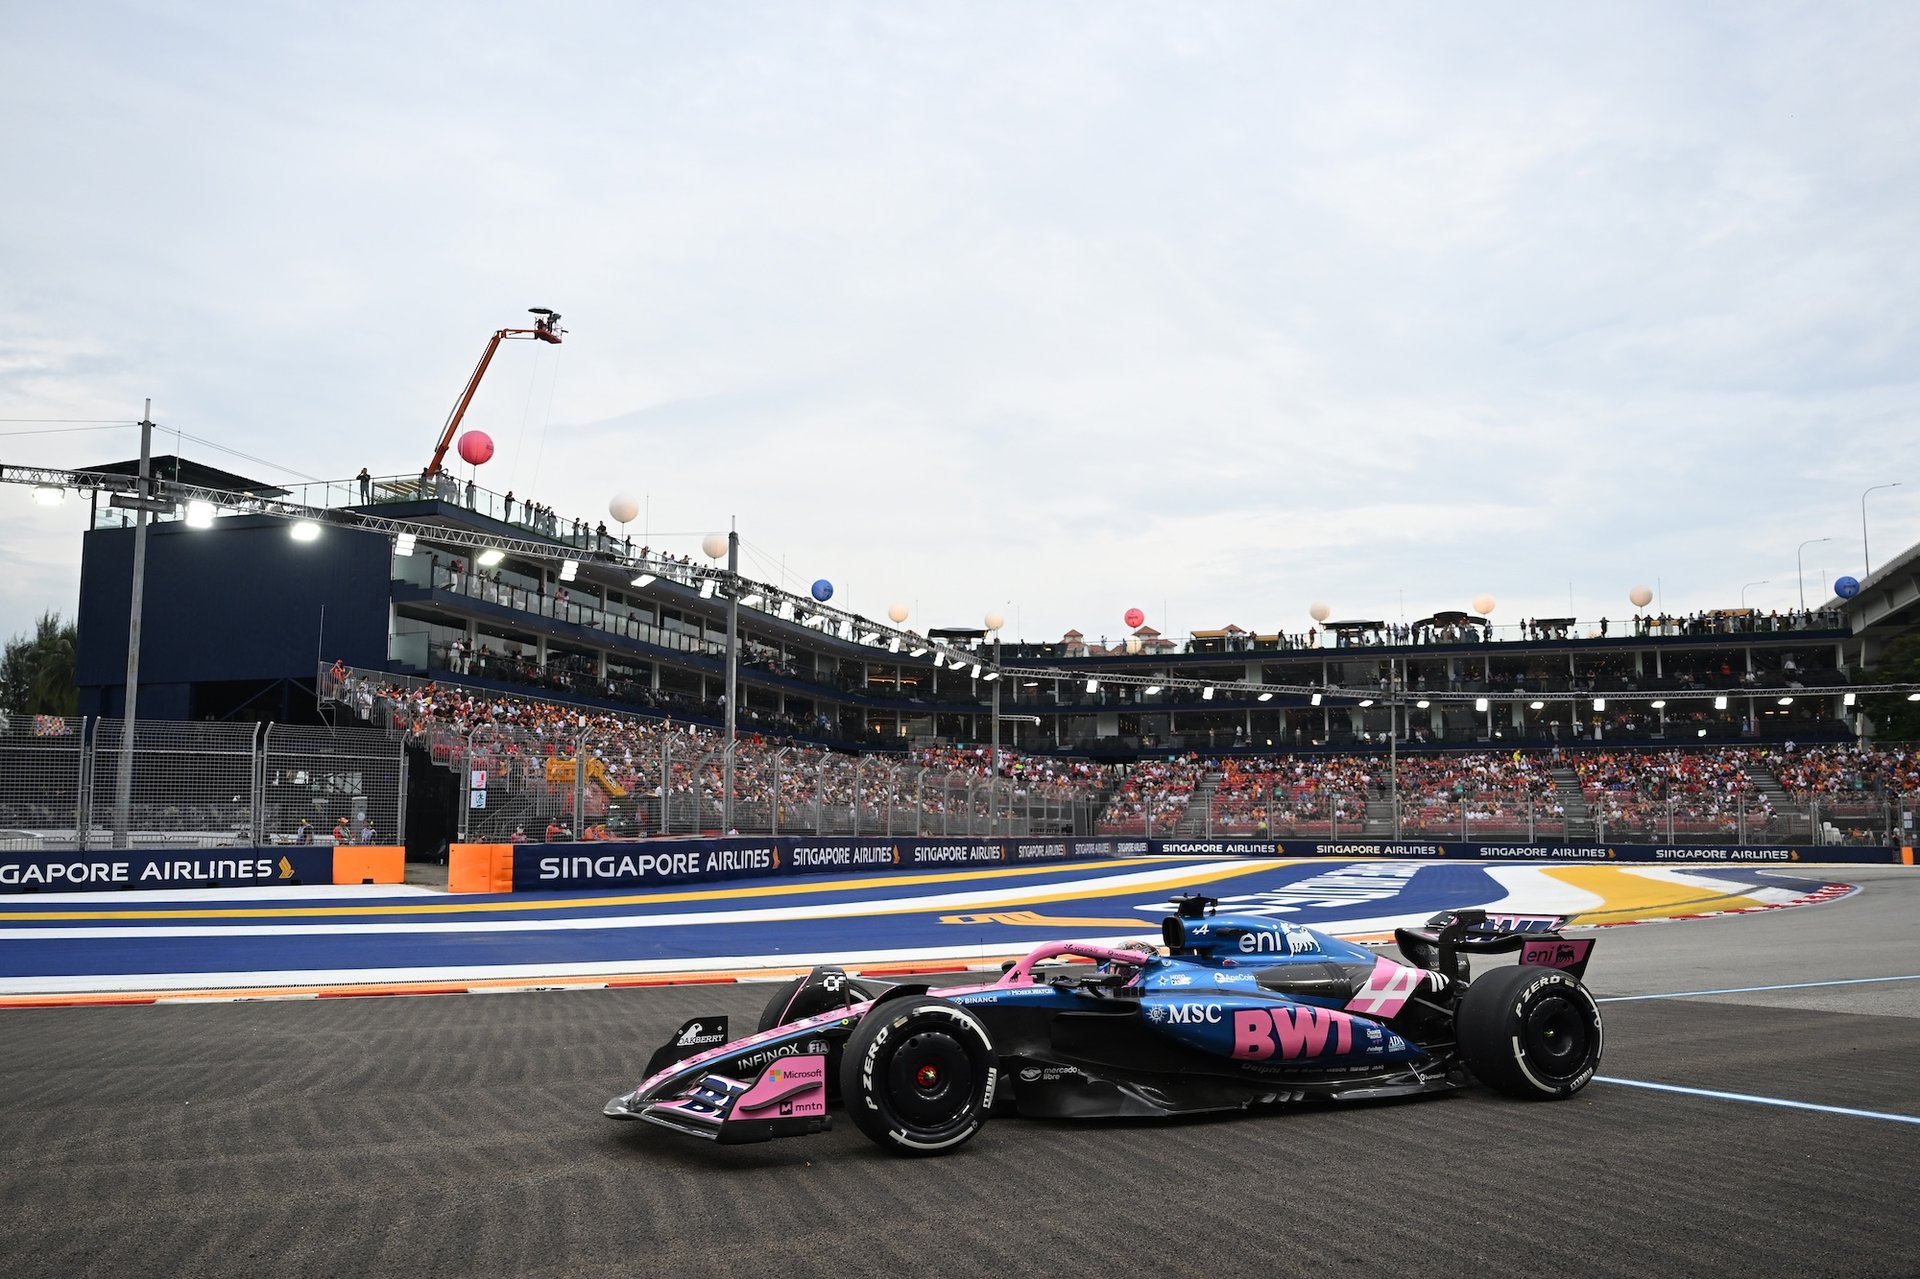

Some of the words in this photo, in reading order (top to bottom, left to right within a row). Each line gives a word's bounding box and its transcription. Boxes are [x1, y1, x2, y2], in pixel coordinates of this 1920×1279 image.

[793, 847, 851, 866] SINGAPORE
[853, 846, 892, 864] AIRLINES
[914, 846, 968, 862] SINGAPORE
[969, 846, 1000, 860] AIRLINES
[1162, 844, 1223, 853] SINGAPORE
[1226, 844, 1275, 853] AIRLINES
[1316, 845, 1380, 854] SINGAPORE
[1384, 846, 1436, 855] AIRLINES
[1480, 848, 1547, 857] SINGAPORE
[1551, 848, 1606, 858] AIRLINES
[1655, 850, 1727, 859] SINGAPORE
[1731, 851, 1789, 860] AIRLINES
[0, 863, 130, 884] GAPORE
[140, 859, 273, 881] AIRLINES
[540, 854, 700, 880] SINGAPORE
[705, 848, 771, 872] AIRLINES
[1238, 924, 1283, 953] eni
[1526, 944, 1555, 963] eni
[1226, 974, 1255, 982] ApeCoin
[1522, 975, 1561, 1003] ZERO
[964, 996, 998, 1004] BINANCE
[1167, 1003, 1222, 1024] MSC
[677, 1034, 725, 1046] OAKBERRY
[1231, 1006, 1354, 1061] BWT
[737, 1043, 800, 1071] INFINOX
[862, 1026, 889, 1091] ZERO
[783, 1069, 823, 1079] Microsoft
[1044, 1066, 1078, 1074] mercado
[983, 1067, 998, 1109] PIRELLI
[795, 1102, 823, 1112] mntn
